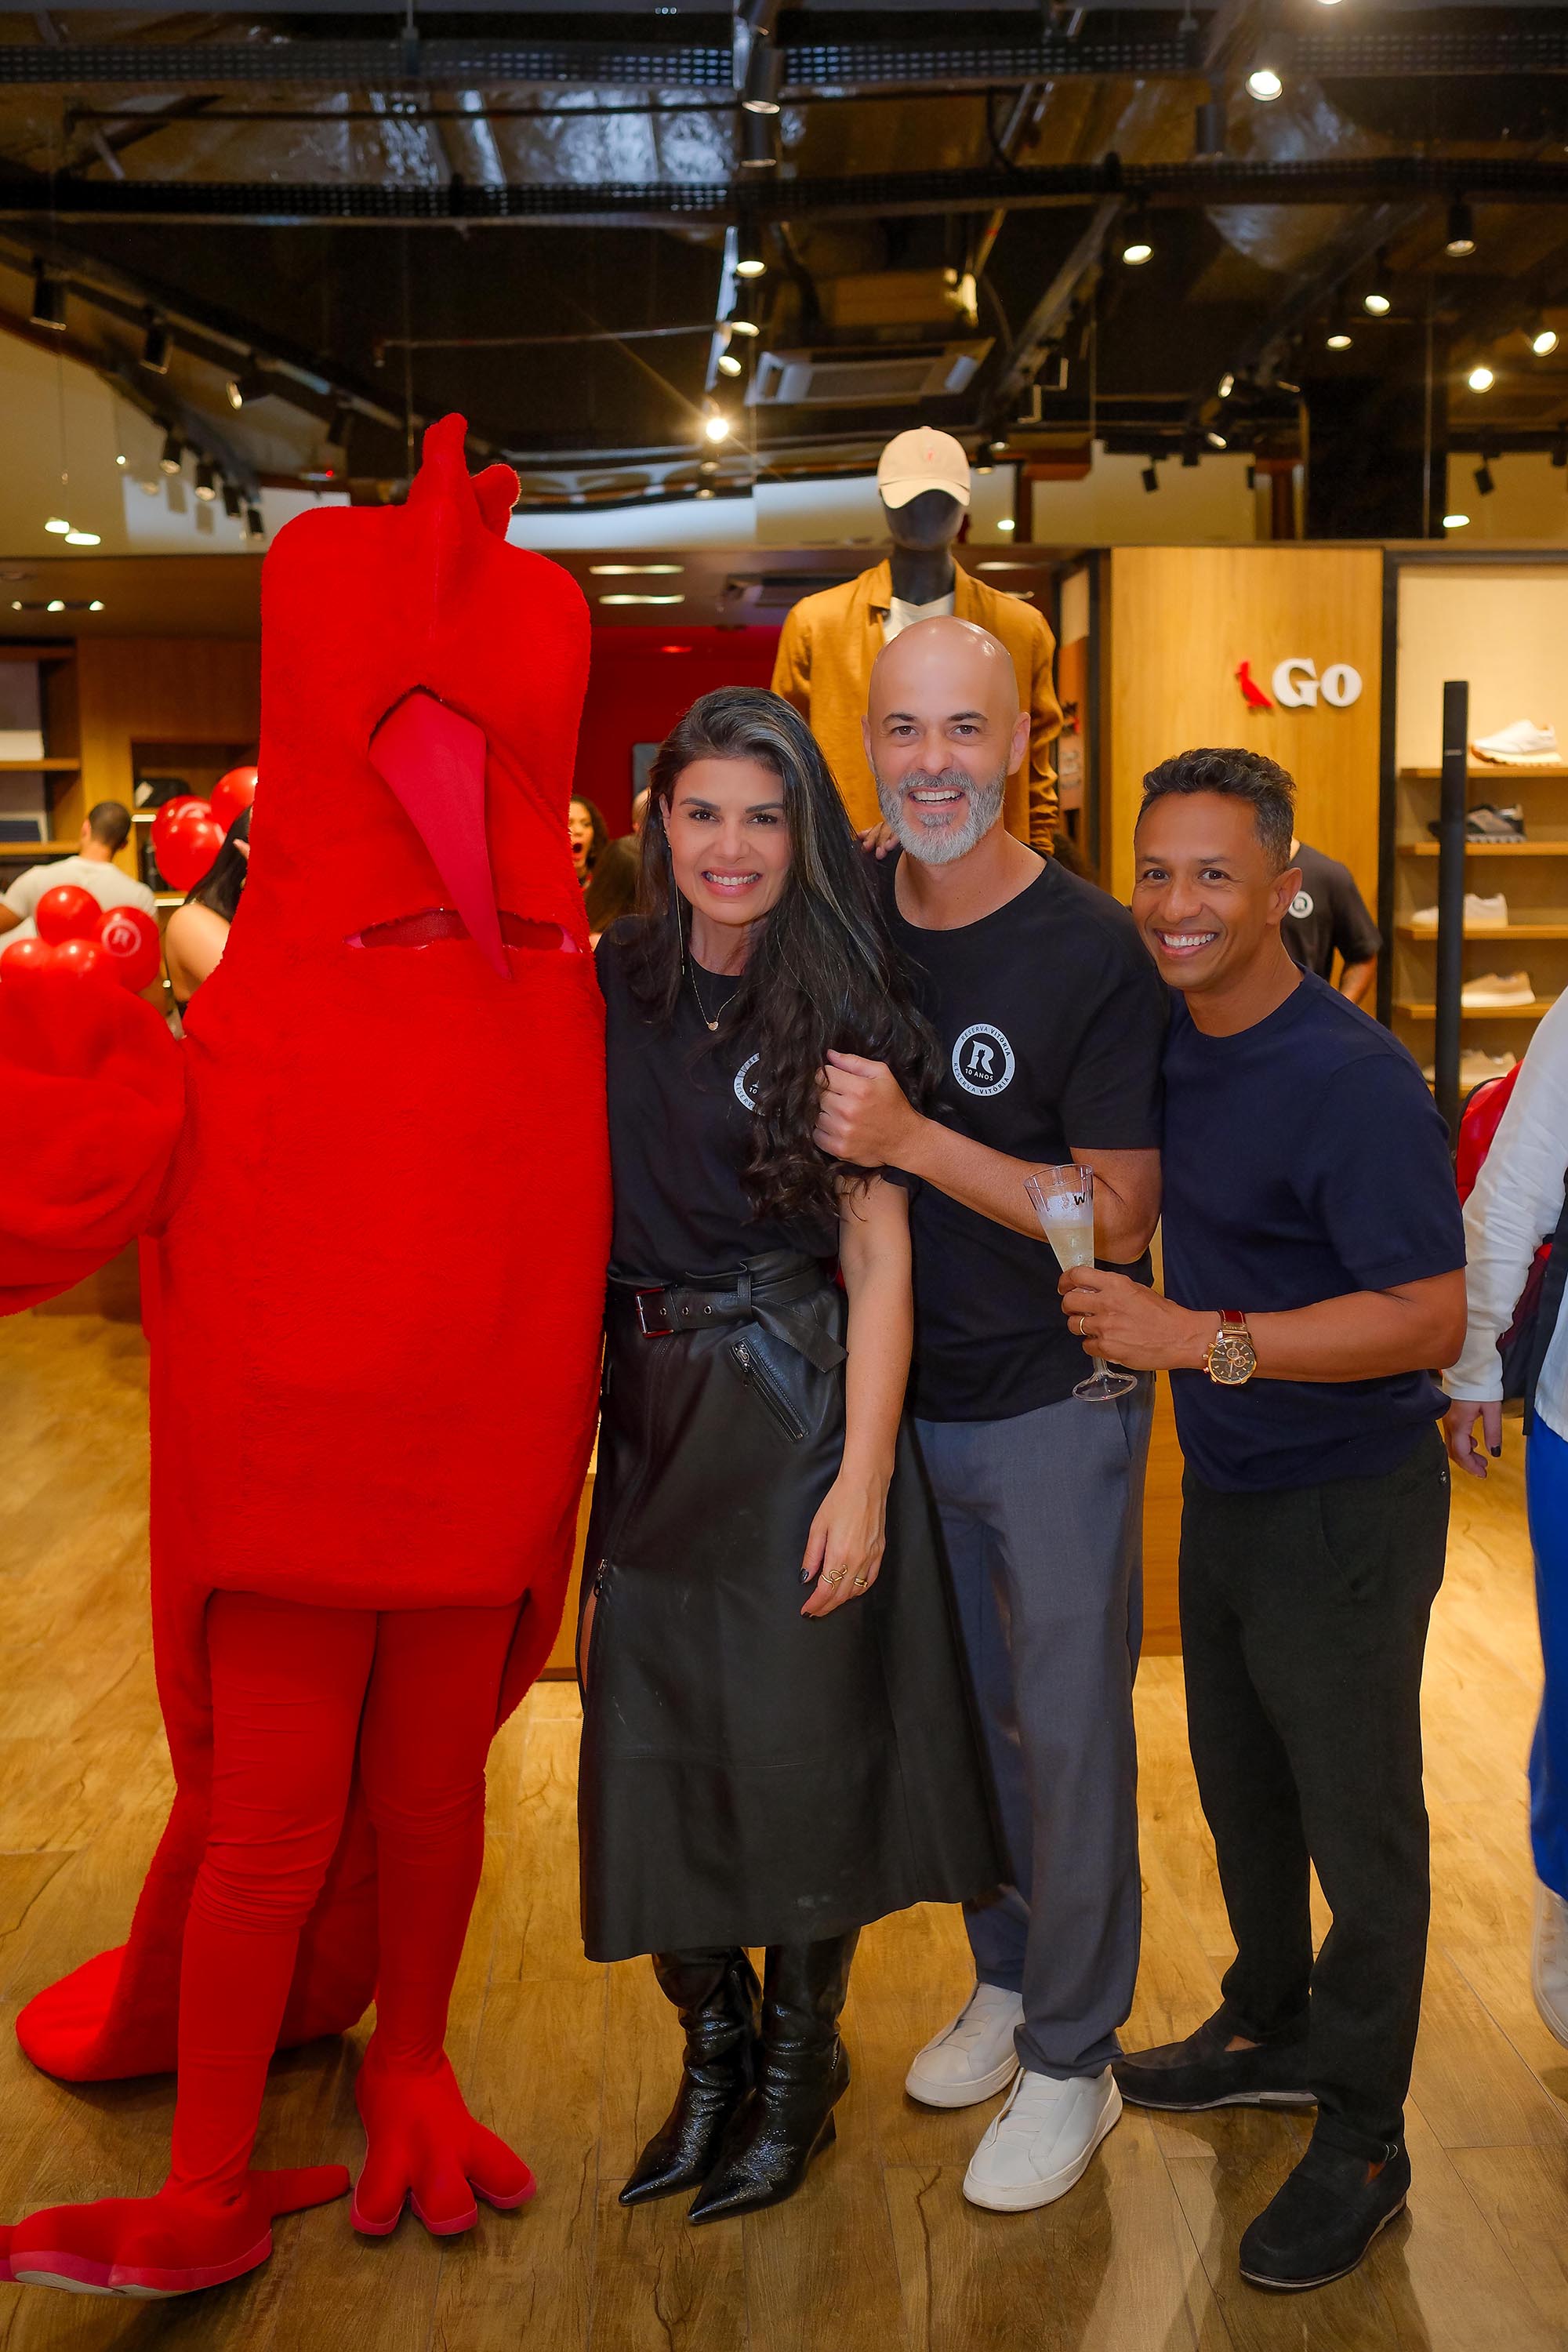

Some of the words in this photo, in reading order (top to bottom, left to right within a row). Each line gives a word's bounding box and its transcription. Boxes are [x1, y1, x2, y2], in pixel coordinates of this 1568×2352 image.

[961, 1025, 988, 1041] RESERVA
[990, 1028, 1011, 1056] VITÓRIA
[953, 1062, 976, 1092] RESERVA
[979, 1077, 1010, 1094] VITÓRIA
[974, 1071, 994, 1081] ANOS
[736, 1082, 754, 1108] RESERV
